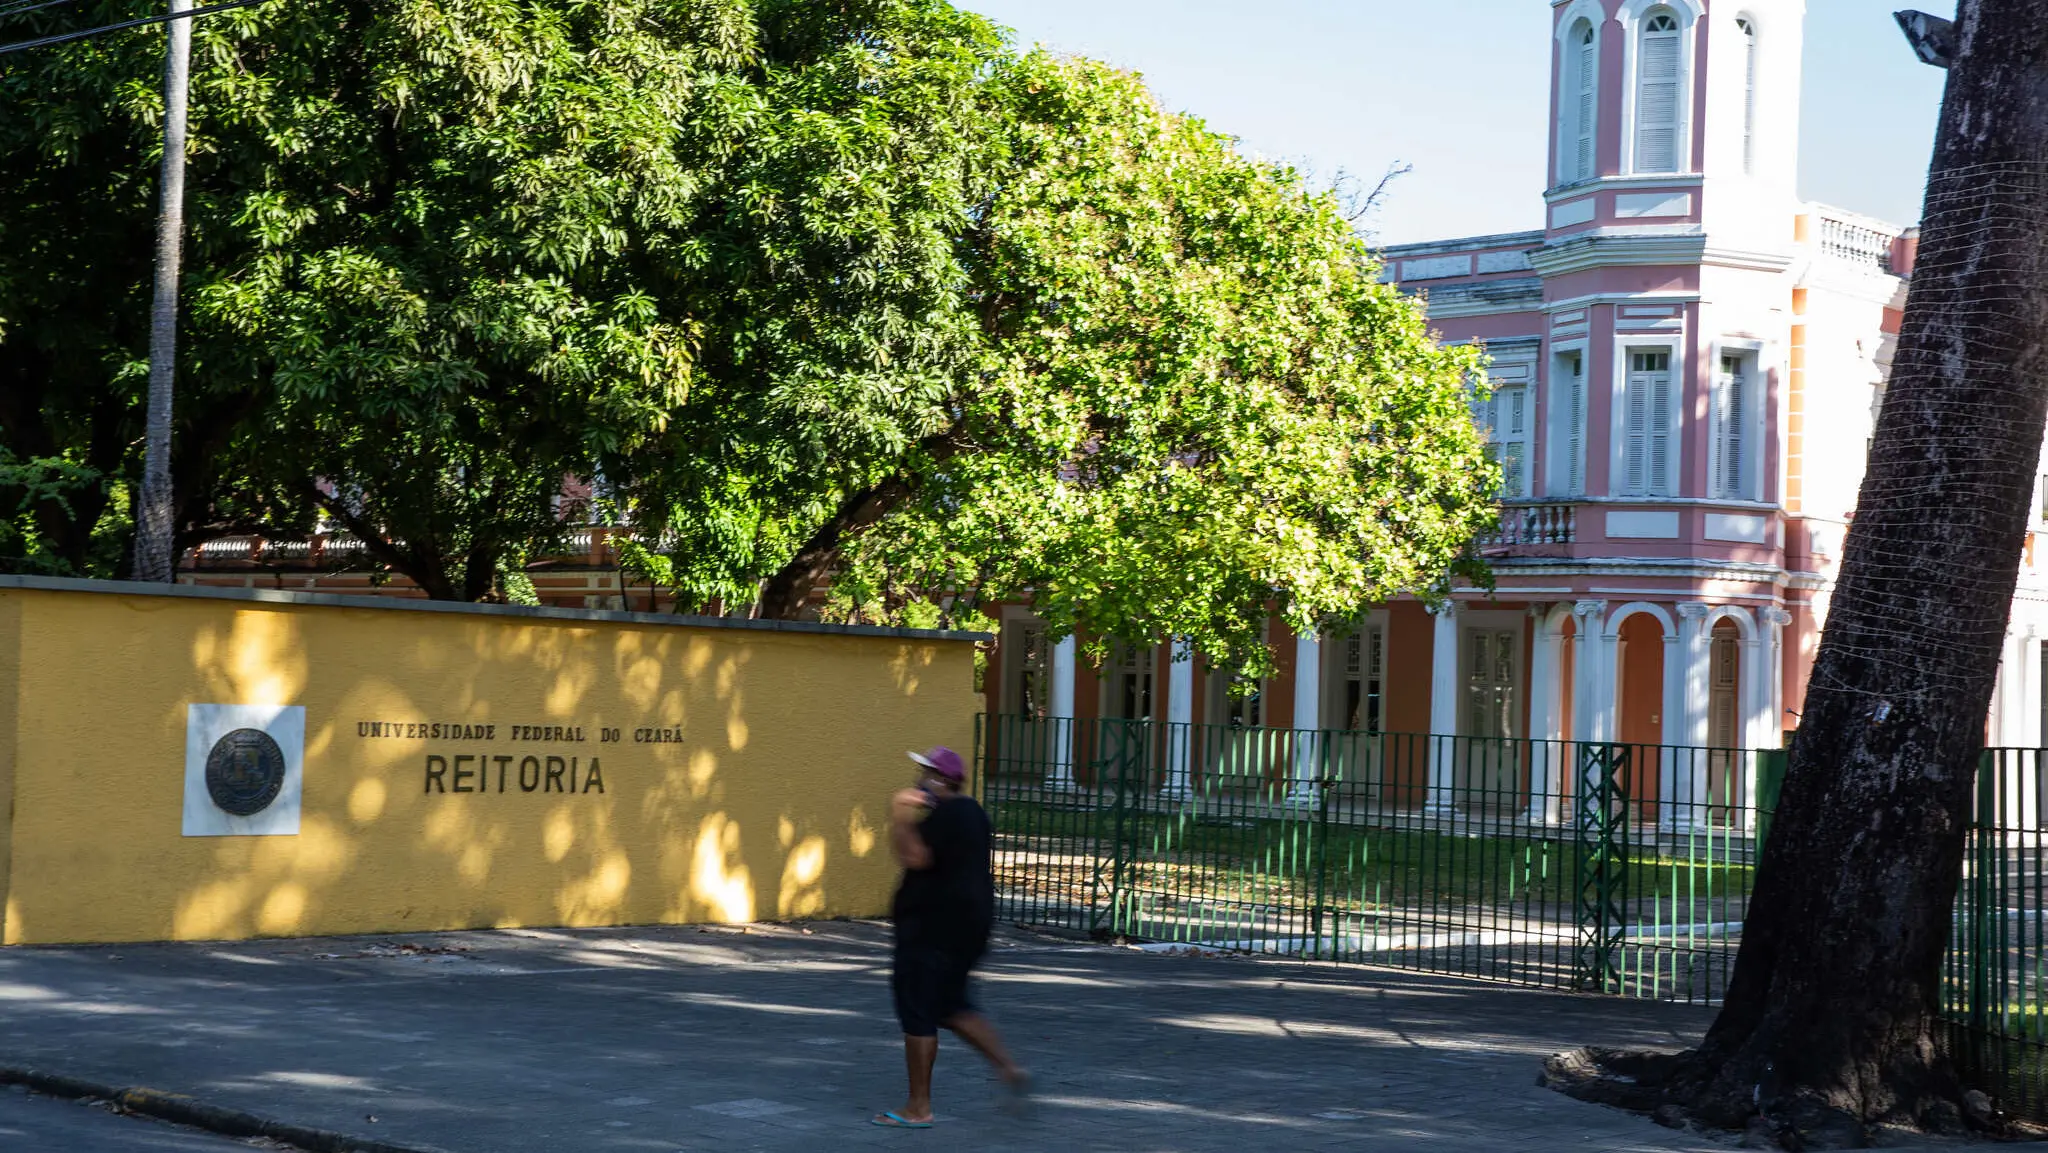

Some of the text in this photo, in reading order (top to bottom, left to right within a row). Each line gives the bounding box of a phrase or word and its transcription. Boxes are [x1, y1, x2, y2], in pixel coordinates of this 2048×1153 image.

[357, 721, 684, 743] UNIVERSIDADE FEDERAL DO CEARÁ
[424, 754, 605, 794] REITORIA
